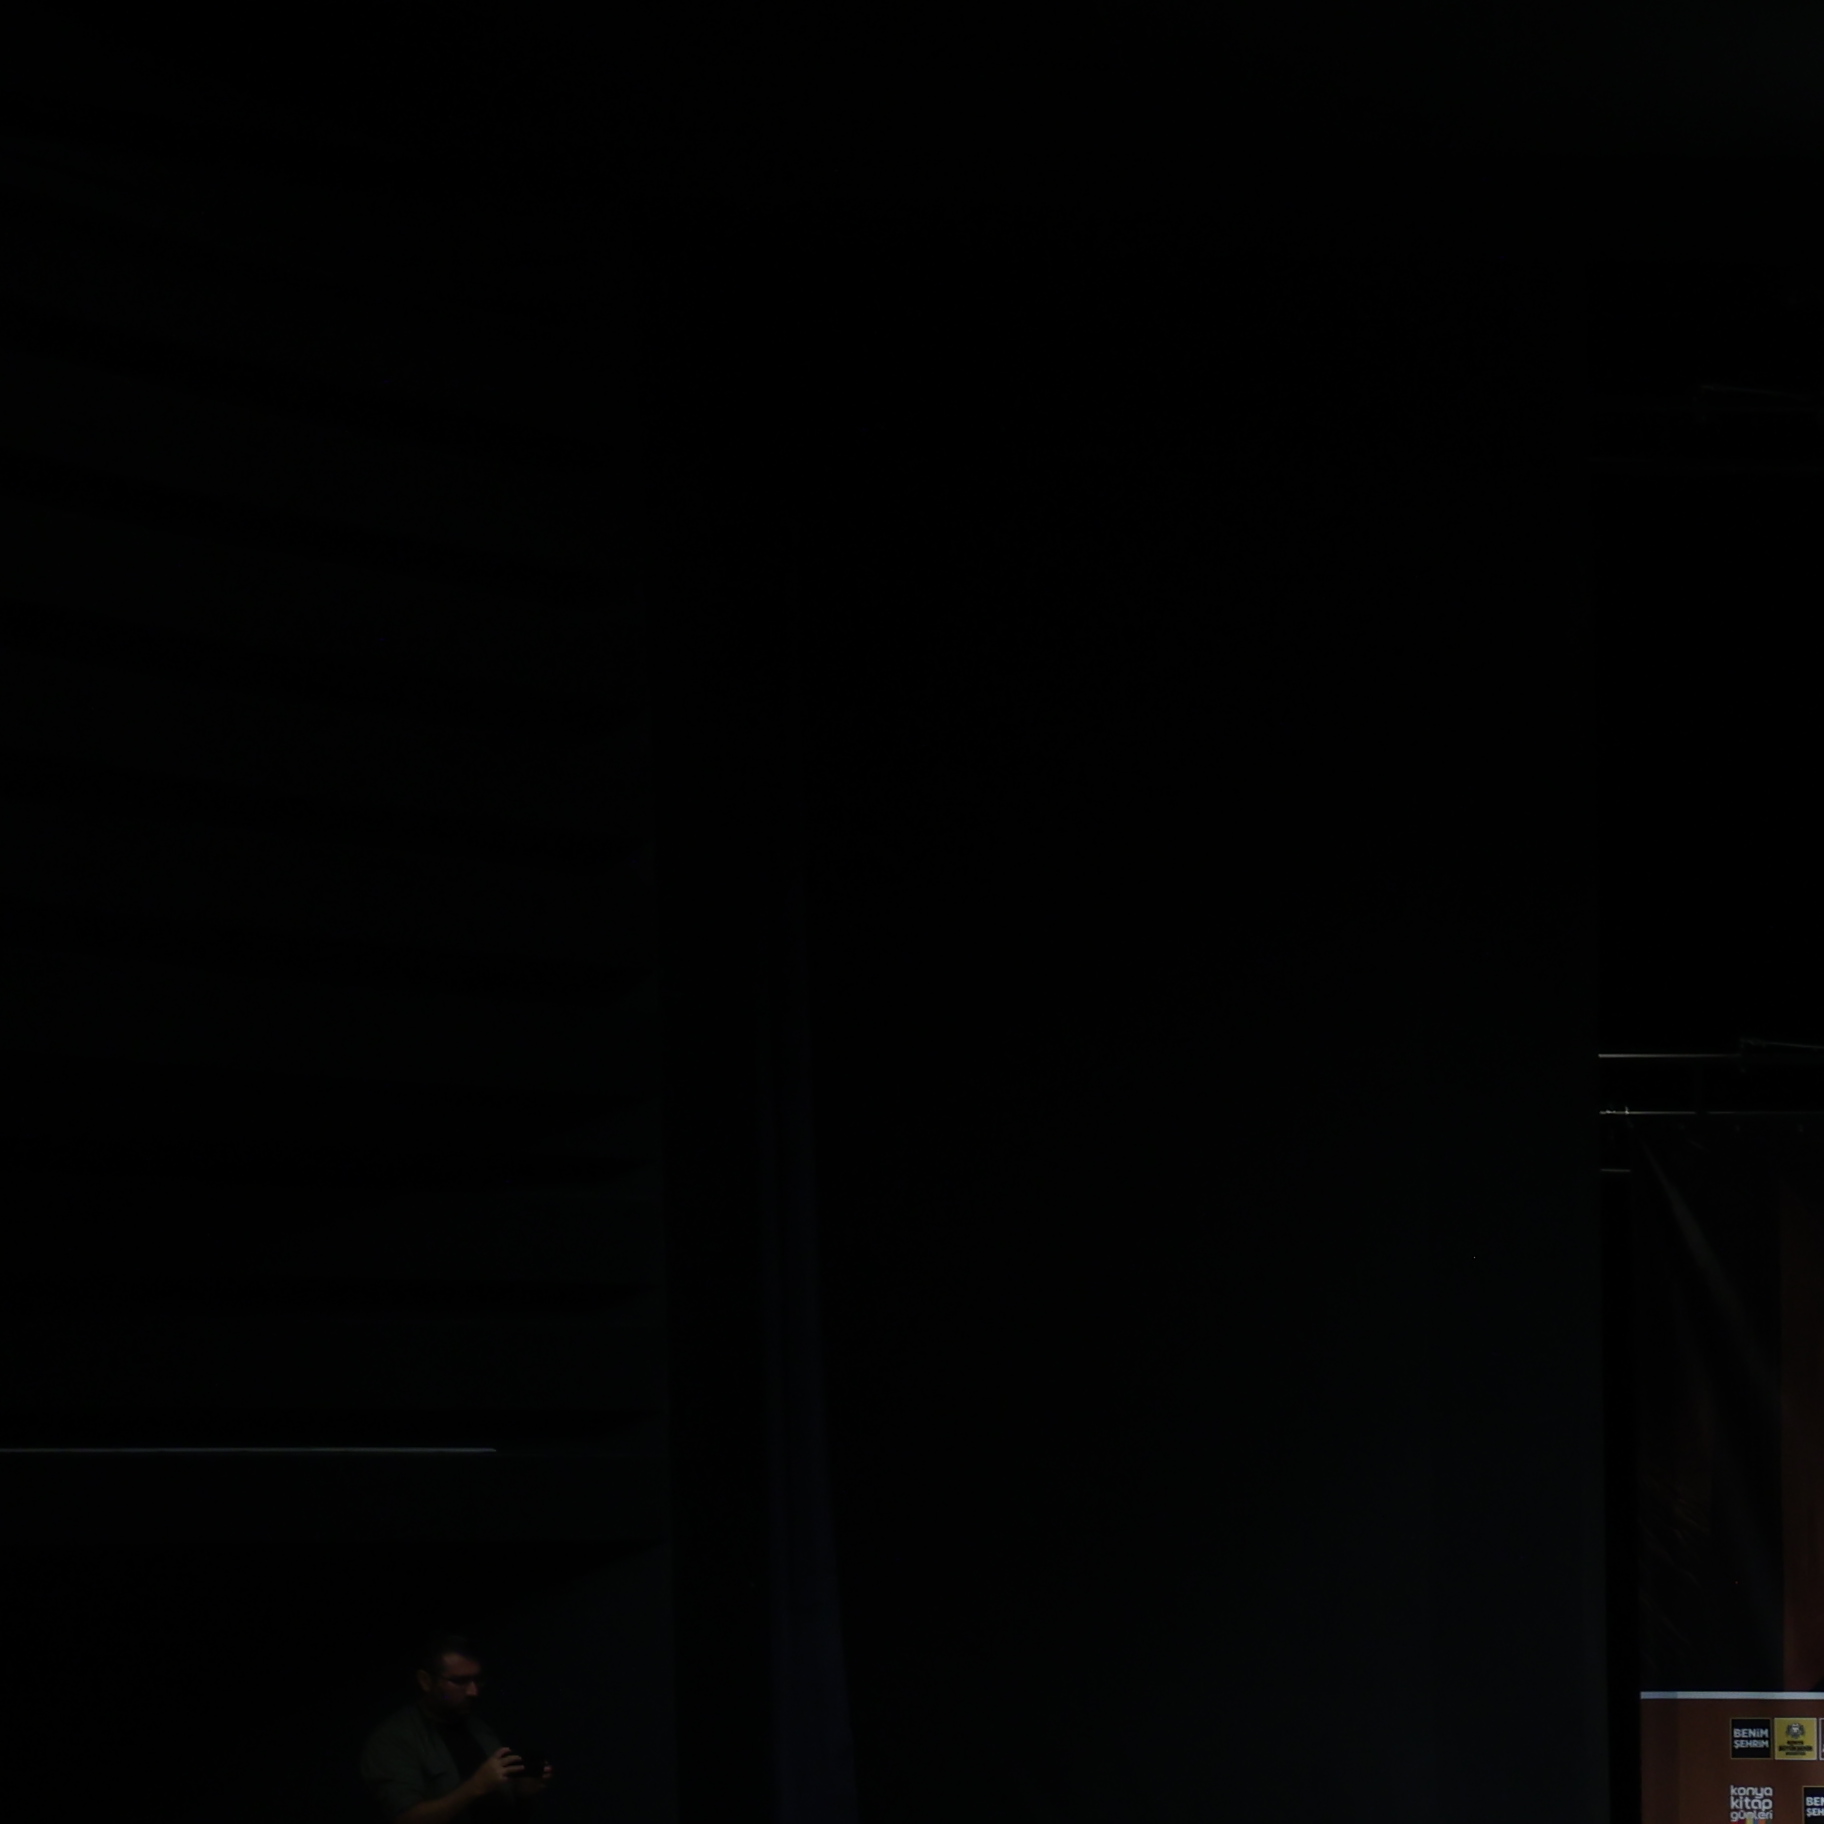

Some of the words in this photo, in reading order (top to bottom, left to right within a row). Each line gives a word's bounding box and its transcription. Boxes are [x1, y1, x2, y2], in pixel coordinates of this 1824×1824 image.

[1730, 1785, 1774, 1799] konya
[1730, 1798, 1774, 1812] kitap
[1730, 1811, 1774, 1823] günleri
